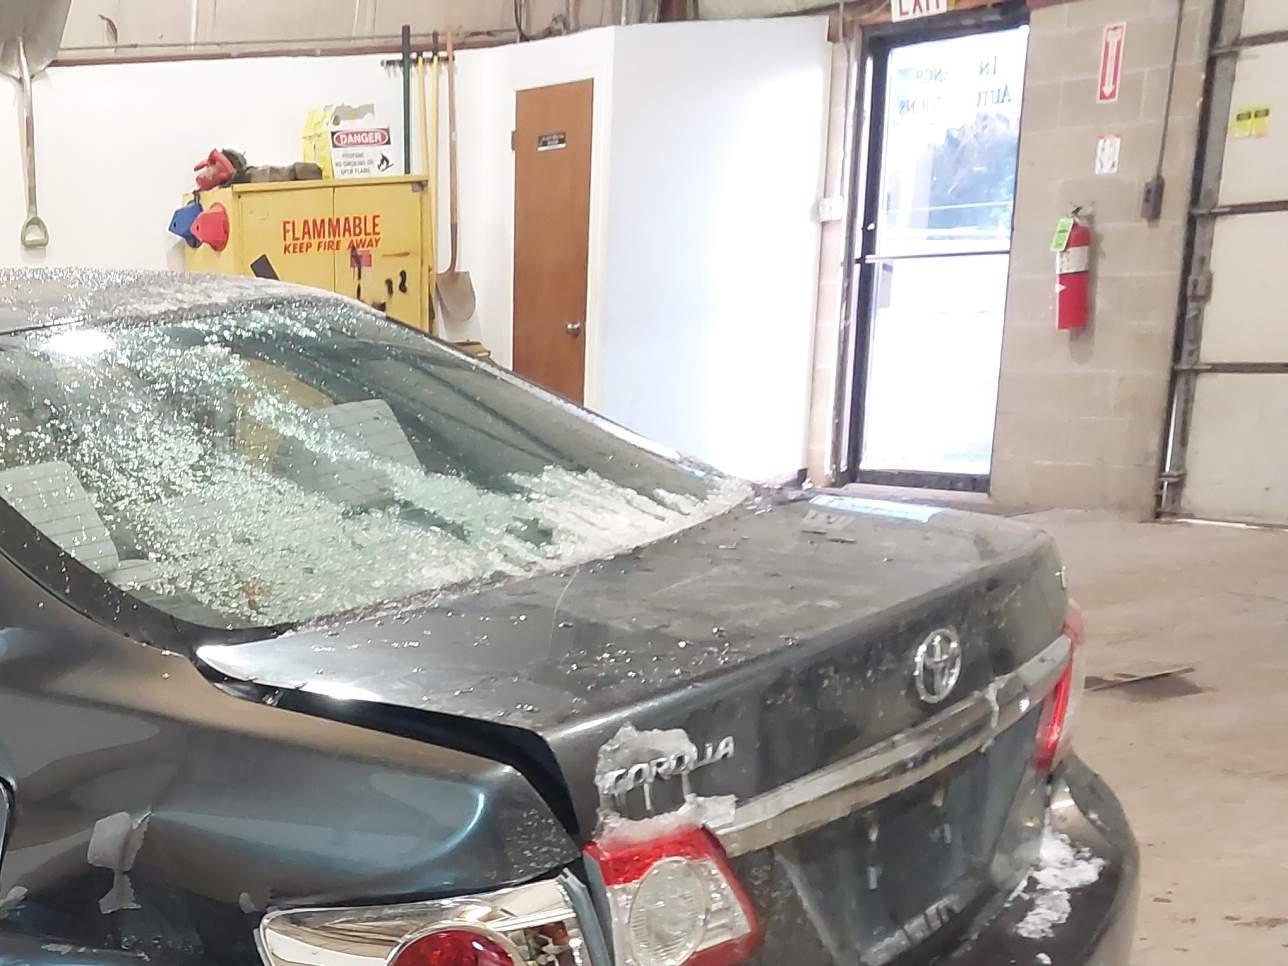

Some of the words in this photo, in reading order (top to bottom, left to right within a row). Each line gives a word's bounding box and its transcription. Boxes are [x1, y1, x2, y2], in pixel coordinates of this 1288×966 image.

[339, 131, 382, 145] DANGER
[282, 215, 381, 242] FLAMMABLE
[283, 241, 313, 255] KEEP
[317, 240, 341, 252] FIRE
[347, 237, 381, 250] AWAY
